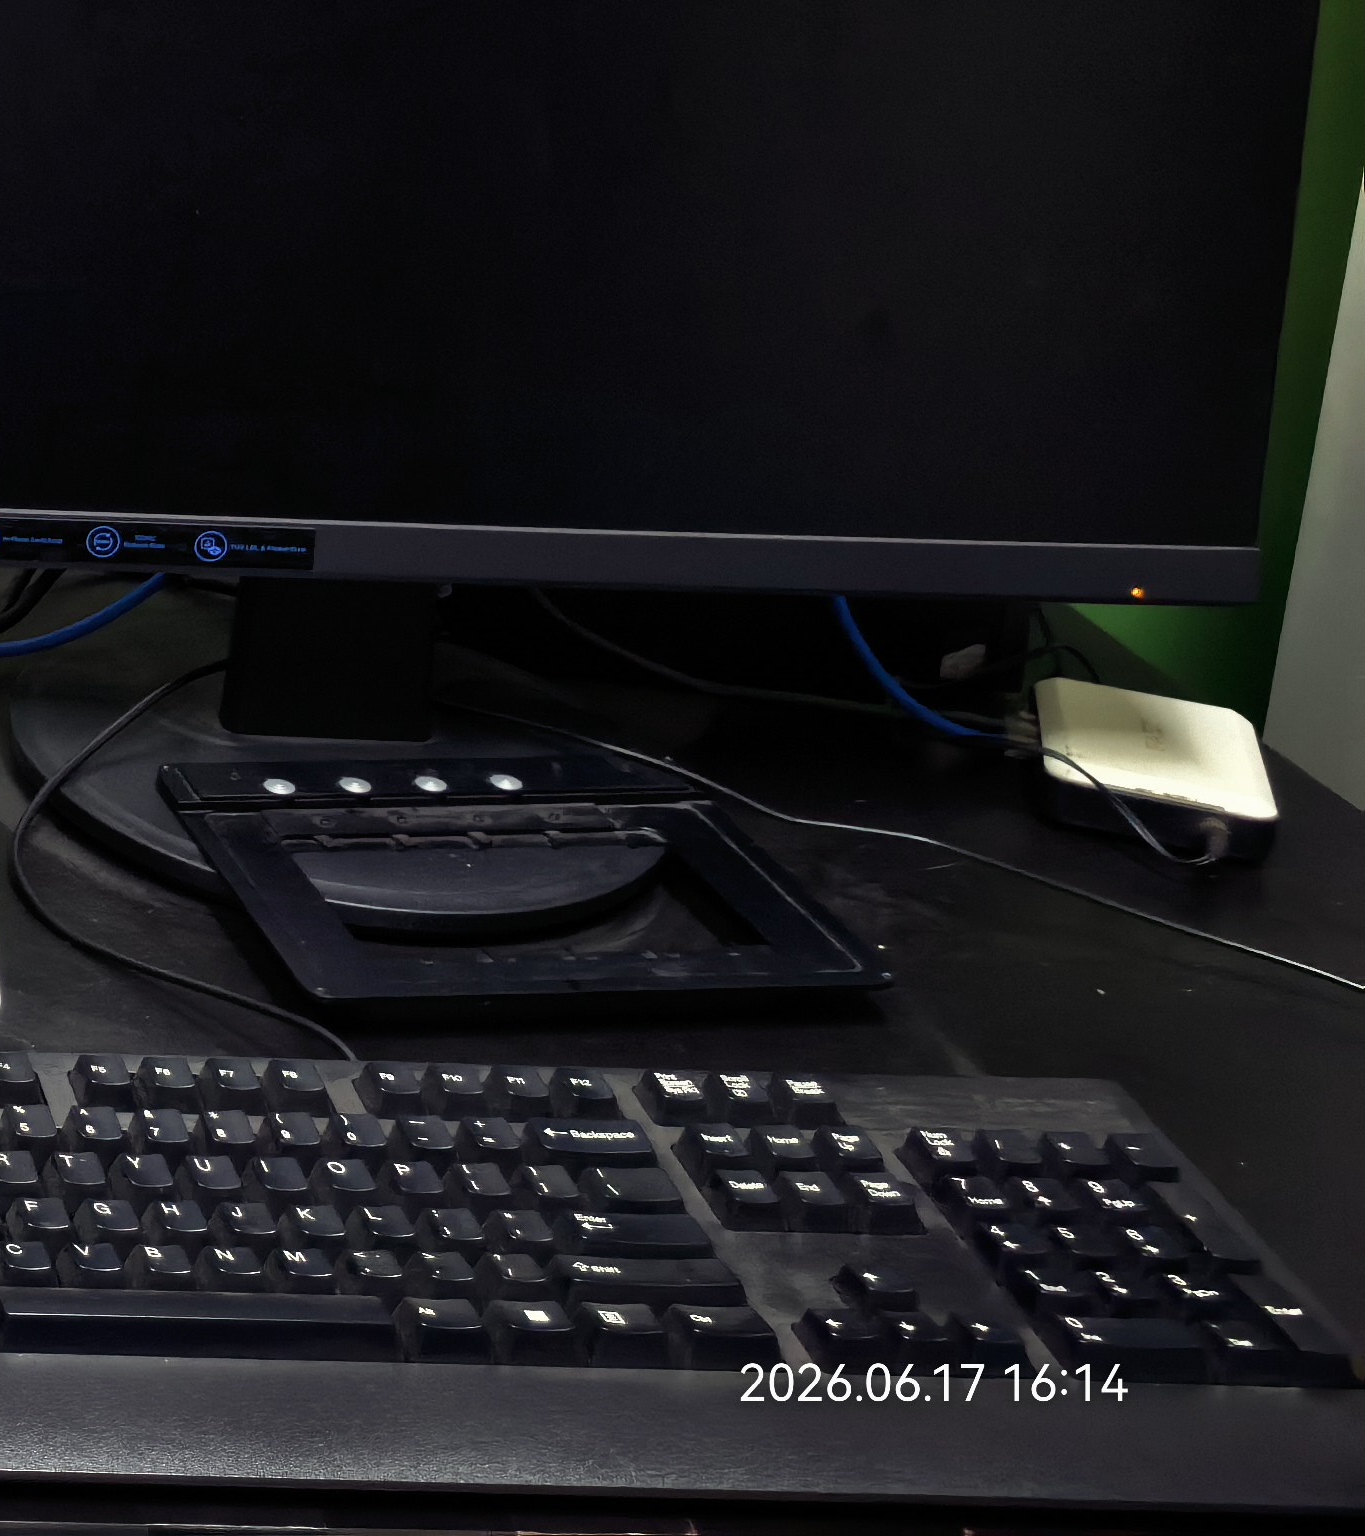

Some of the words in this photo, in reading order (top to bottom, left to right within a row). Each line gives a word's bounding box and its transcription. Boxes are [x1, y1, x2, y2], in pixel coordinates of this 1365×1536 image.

[570, 1129, 635, 1140] Backspace
[59, 1154, 73, 1167] T
[126, 1156, 141, 1168] Y
[194, 1158, 210, 1172] U
[327, 1161, 346, 1174] O
[394, 1163, 411, 1176] P
[24, 1200, 39, 1212] F
[94, 1202, 112, 1215] G
[162, 1203, 180, 1216] H
[232, 1206, 243, 1217] J
[296, 1207, 315, 1220] K
[363, 1208, 382, 1221] L
[6, 1244, 23, 1255] C
[74, 1244, 89, 1256] V
[144, 1246, 162, 1257] B
[214, 1249, 235, 1260] N
[283, 1250, 306, 1262] M
